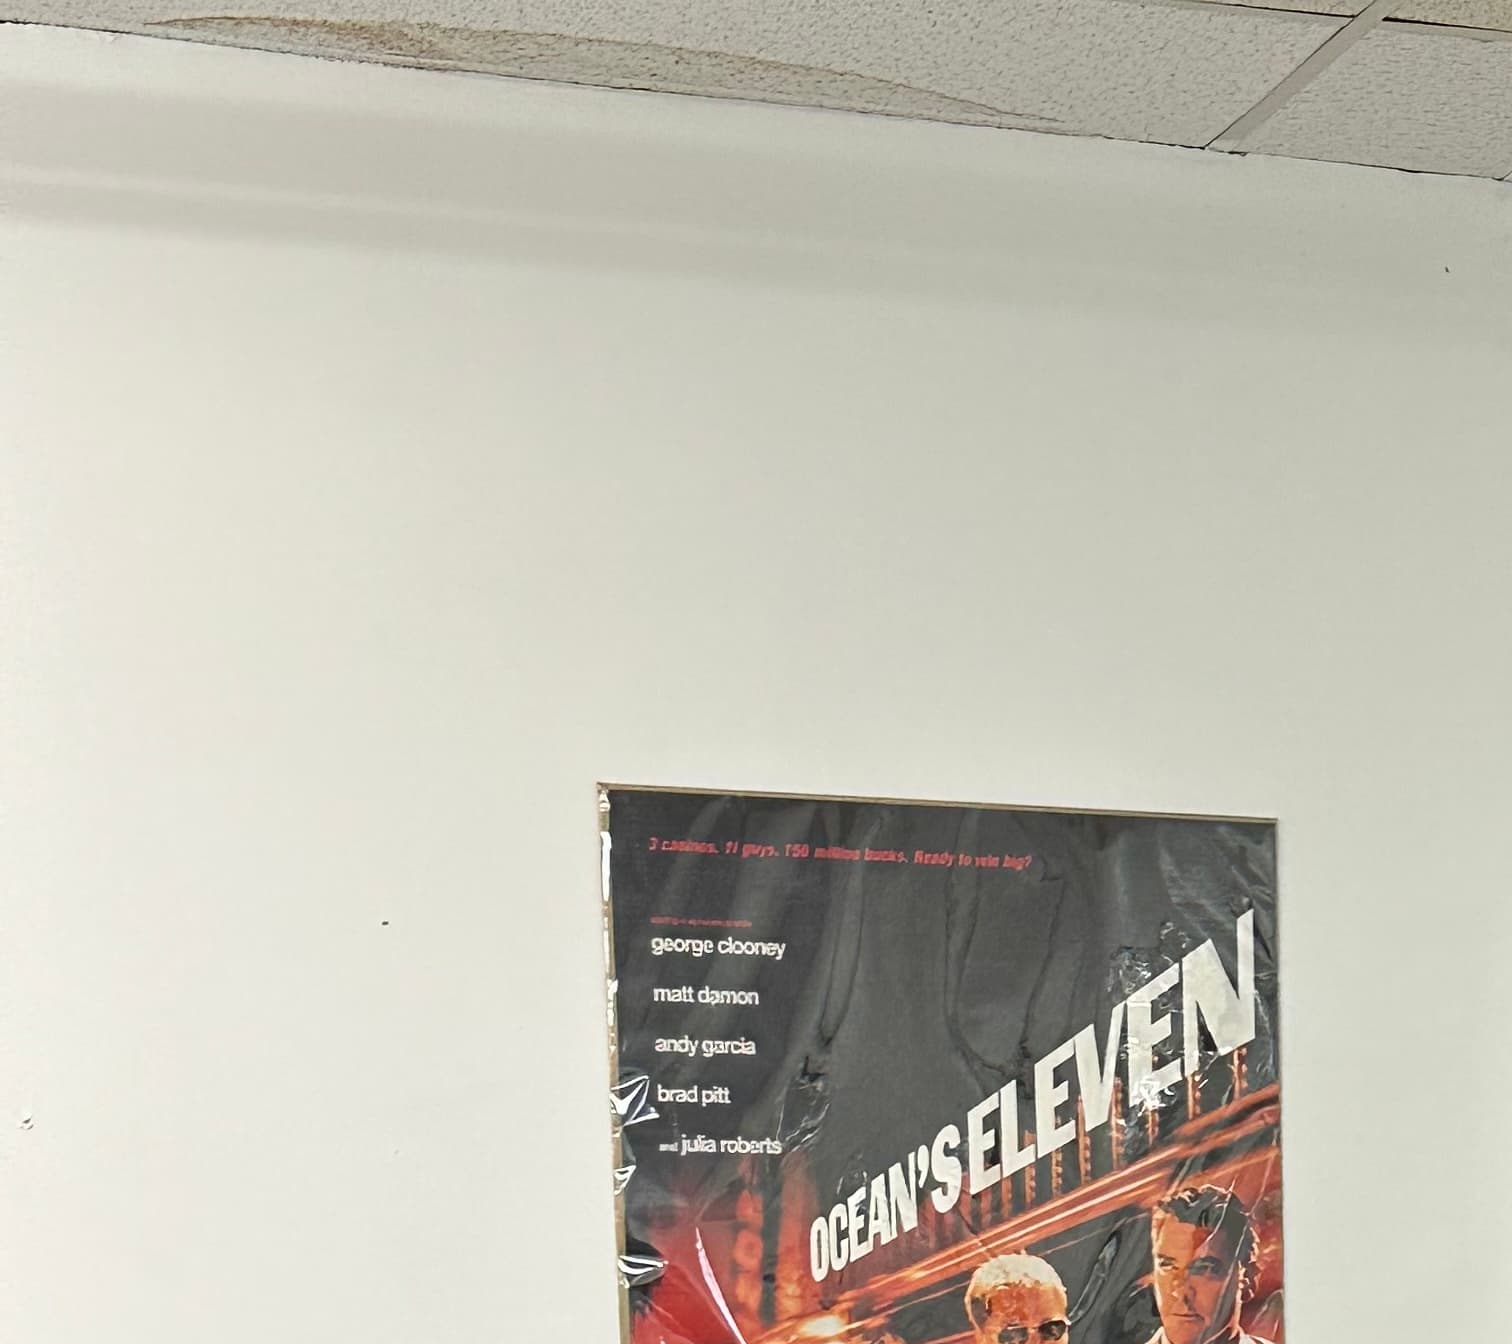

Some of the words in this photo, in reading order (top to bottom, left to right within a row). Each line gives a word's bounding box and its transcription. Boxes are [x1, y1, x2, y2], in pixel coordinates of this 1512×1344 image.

[651, 936, 714, 957] george
[717, 937, 786, 960] clooney
[653, 985, 695, 1004] matt
[697, 985, 760, 1006] damon
[654, 1033, 700, 1057] andy
[701, 1036, 757, 1058] garcia
[656, 1084, 698, 1104] brad
[701, 1085, 731, 1107] pitt
[810, 1122, 963, 1284] OCEAN'S
[967, 908, 1256, 1197] ELEVEN
[680, 1133, 717, 1156] julia
[720, 1135, 782, 1155] roberts
